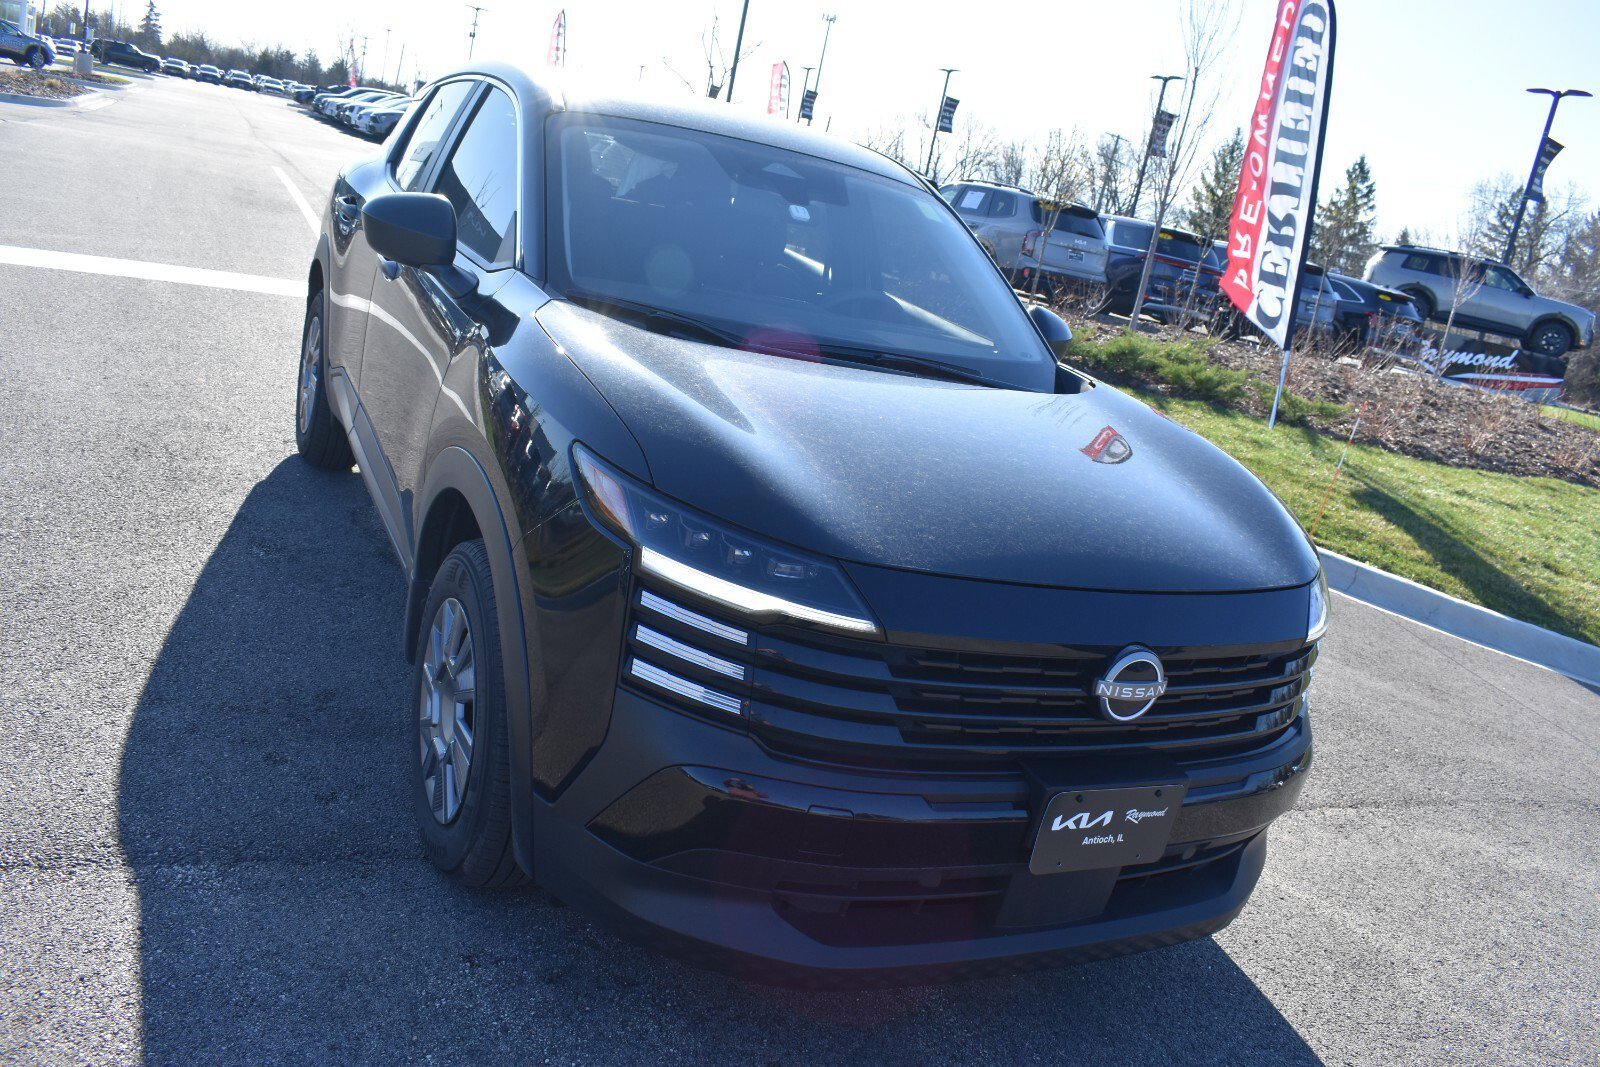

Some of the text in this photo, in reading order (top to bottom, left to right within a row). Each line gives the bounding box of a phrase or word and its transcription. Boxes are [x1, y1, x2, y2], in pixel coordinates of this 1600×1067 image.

[1098, 683, 1166, 698] NISSAN
[1051, 807, 1168, 831] KIA Raymond
[1082, 834, 1124, 846] Antioch, IL
